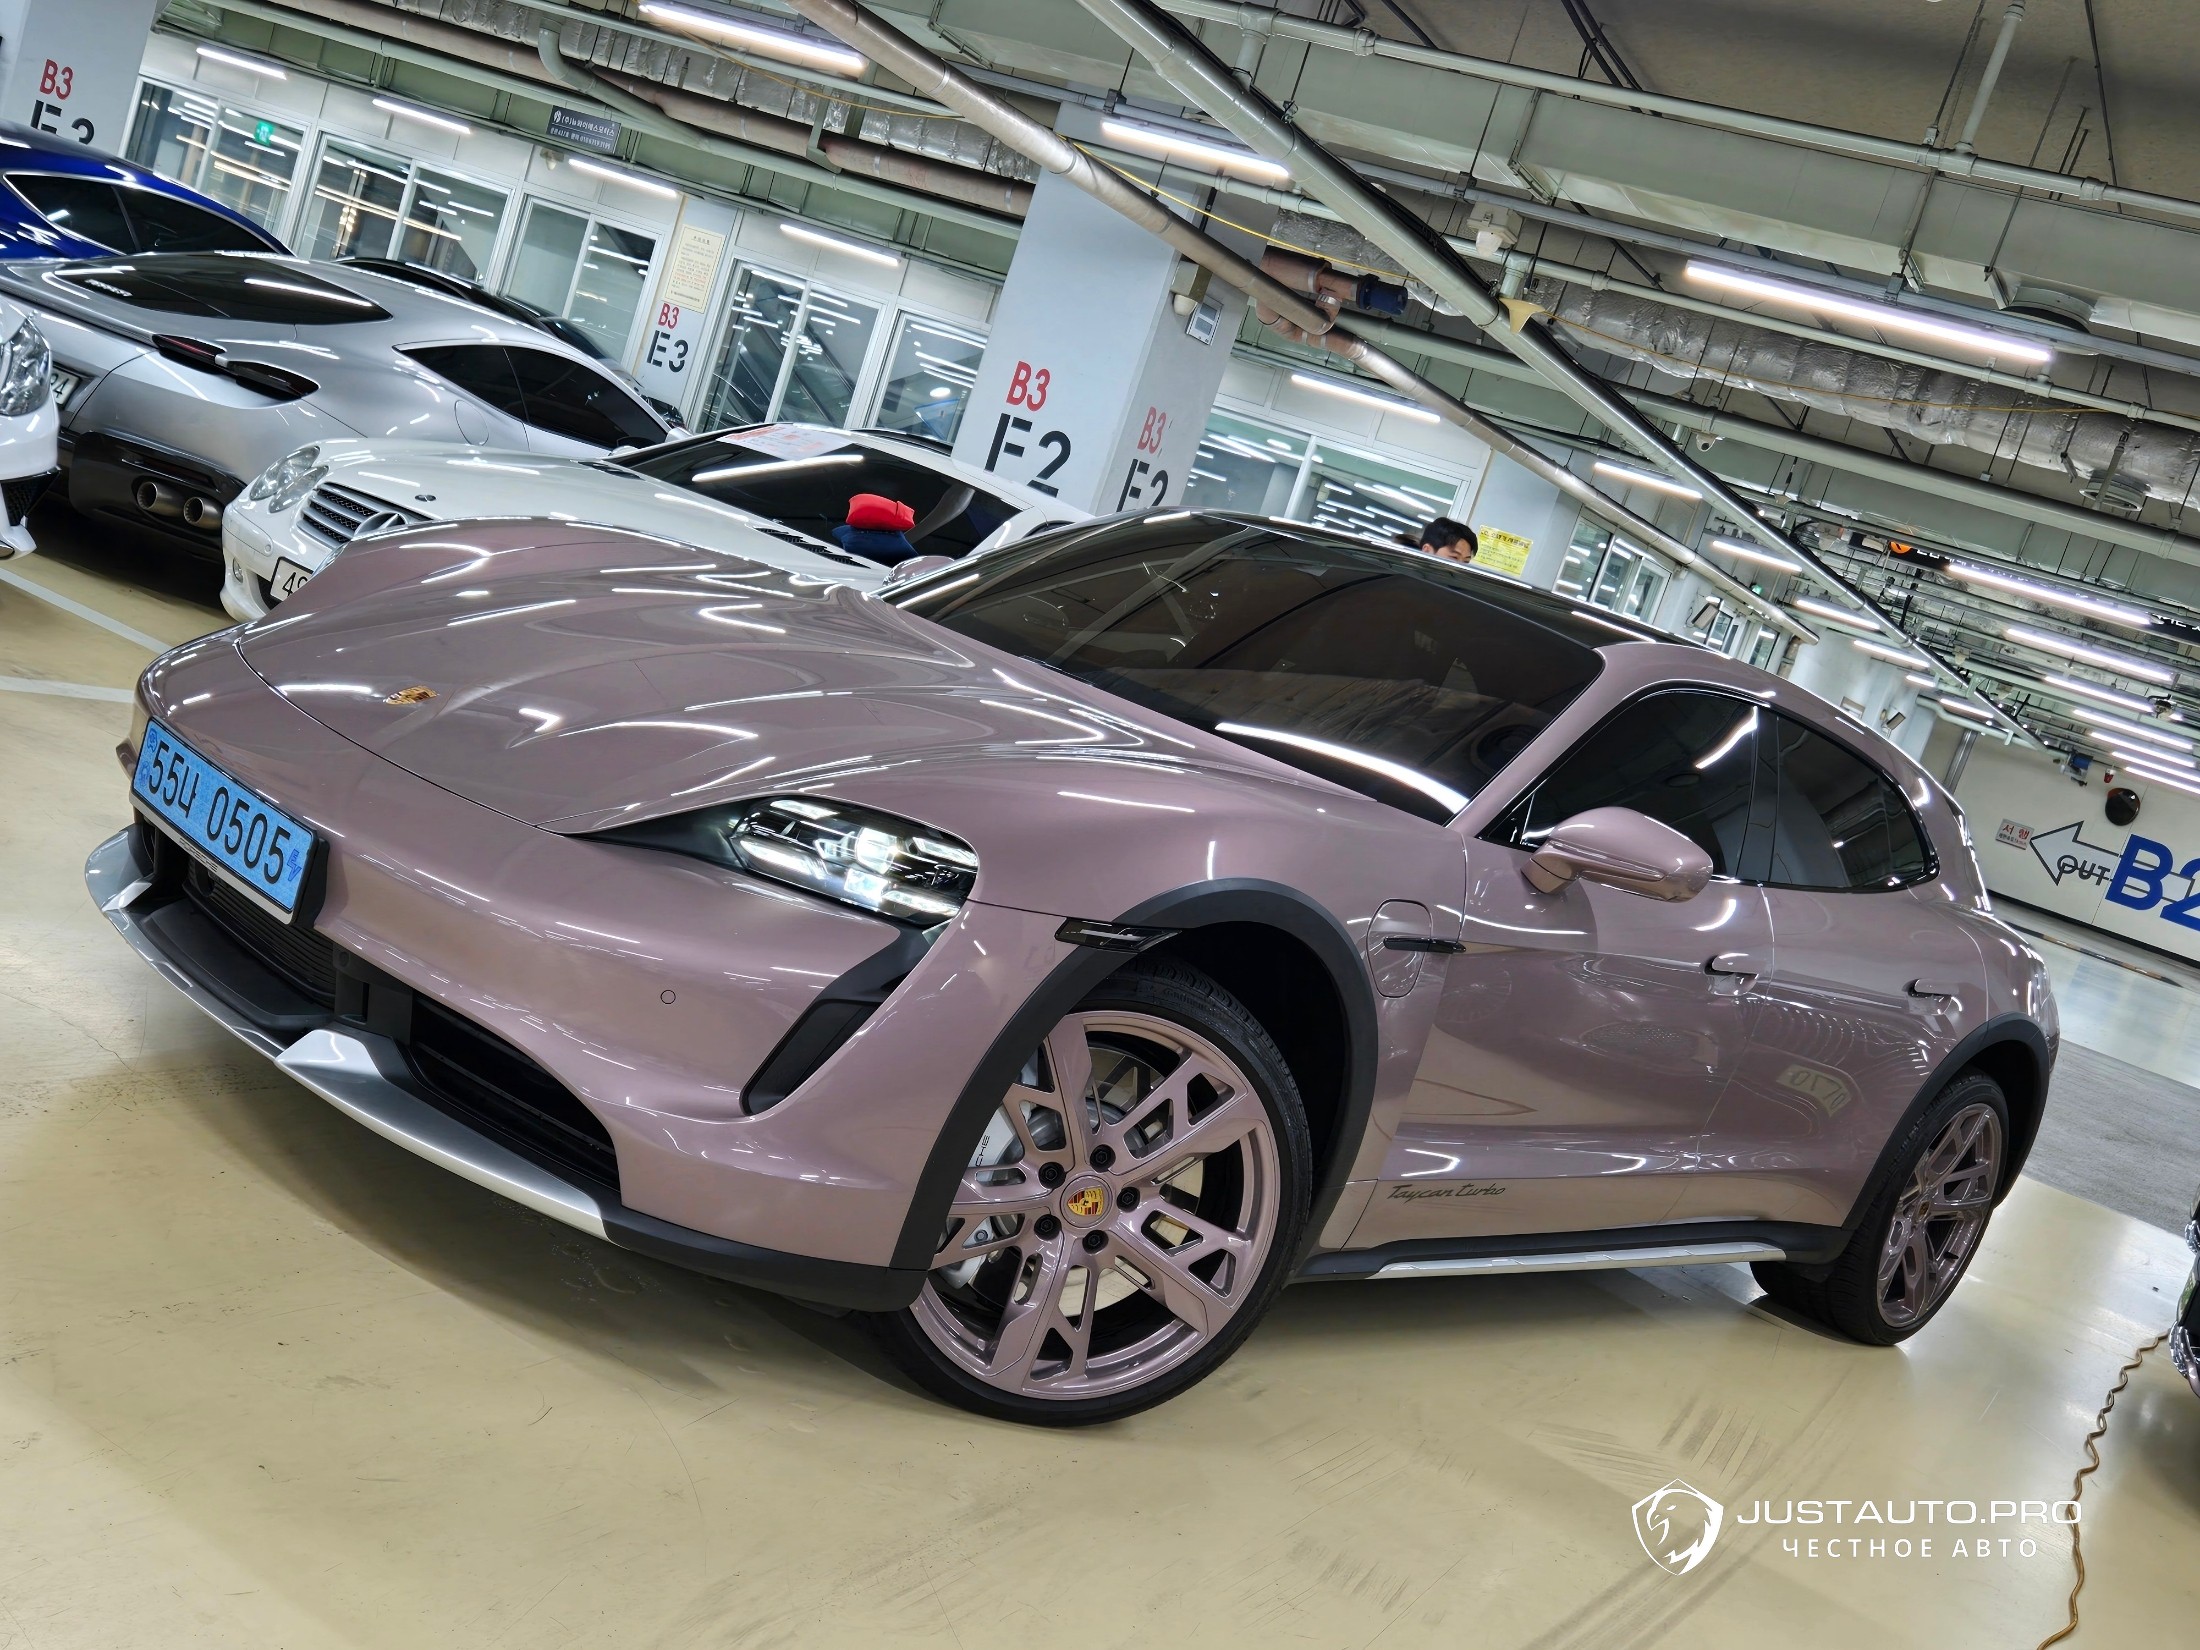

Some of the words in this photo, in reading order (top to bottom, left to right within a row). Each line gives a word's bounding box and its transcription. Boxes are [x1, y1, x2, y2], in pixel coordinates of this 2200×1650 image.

[39, 58, 74, 100] B3
[658, 302, 680, 329] B3
[646, 329, 689, 373] E3
[1006, 360, 1051, 412] B3
[1137, 406, 1167, 454] B3
[206, 786, 291, 885] 0505
[2056, 854, 2111, 886] OUT
[2105, 833, 2200, 934] B2
[1386, 1184, 1454, 1205] Taycan
